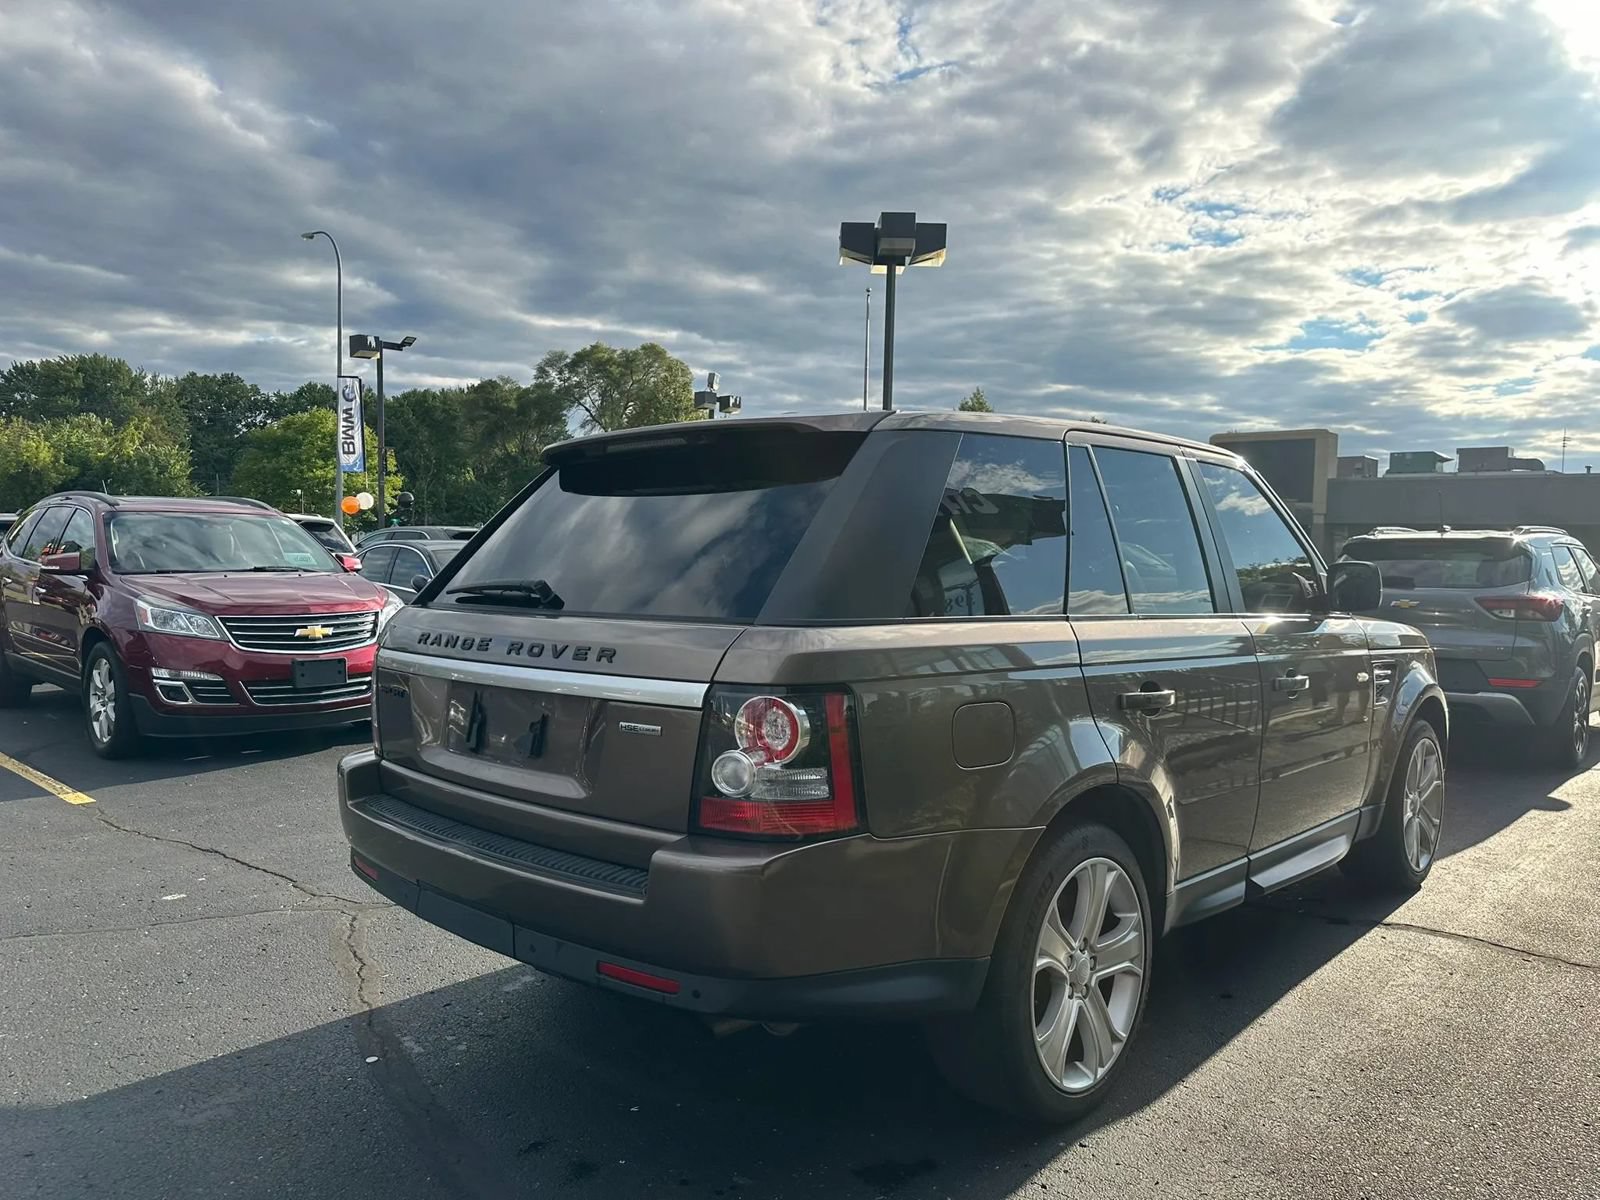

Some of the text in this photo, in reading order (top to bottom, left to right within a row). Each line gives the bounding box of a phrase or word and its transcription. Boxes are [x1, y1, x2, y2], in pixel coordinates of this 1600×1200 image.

[416, 631, 617, 664] RANGE ROVER
[620, 723, 639, 732] HSE
